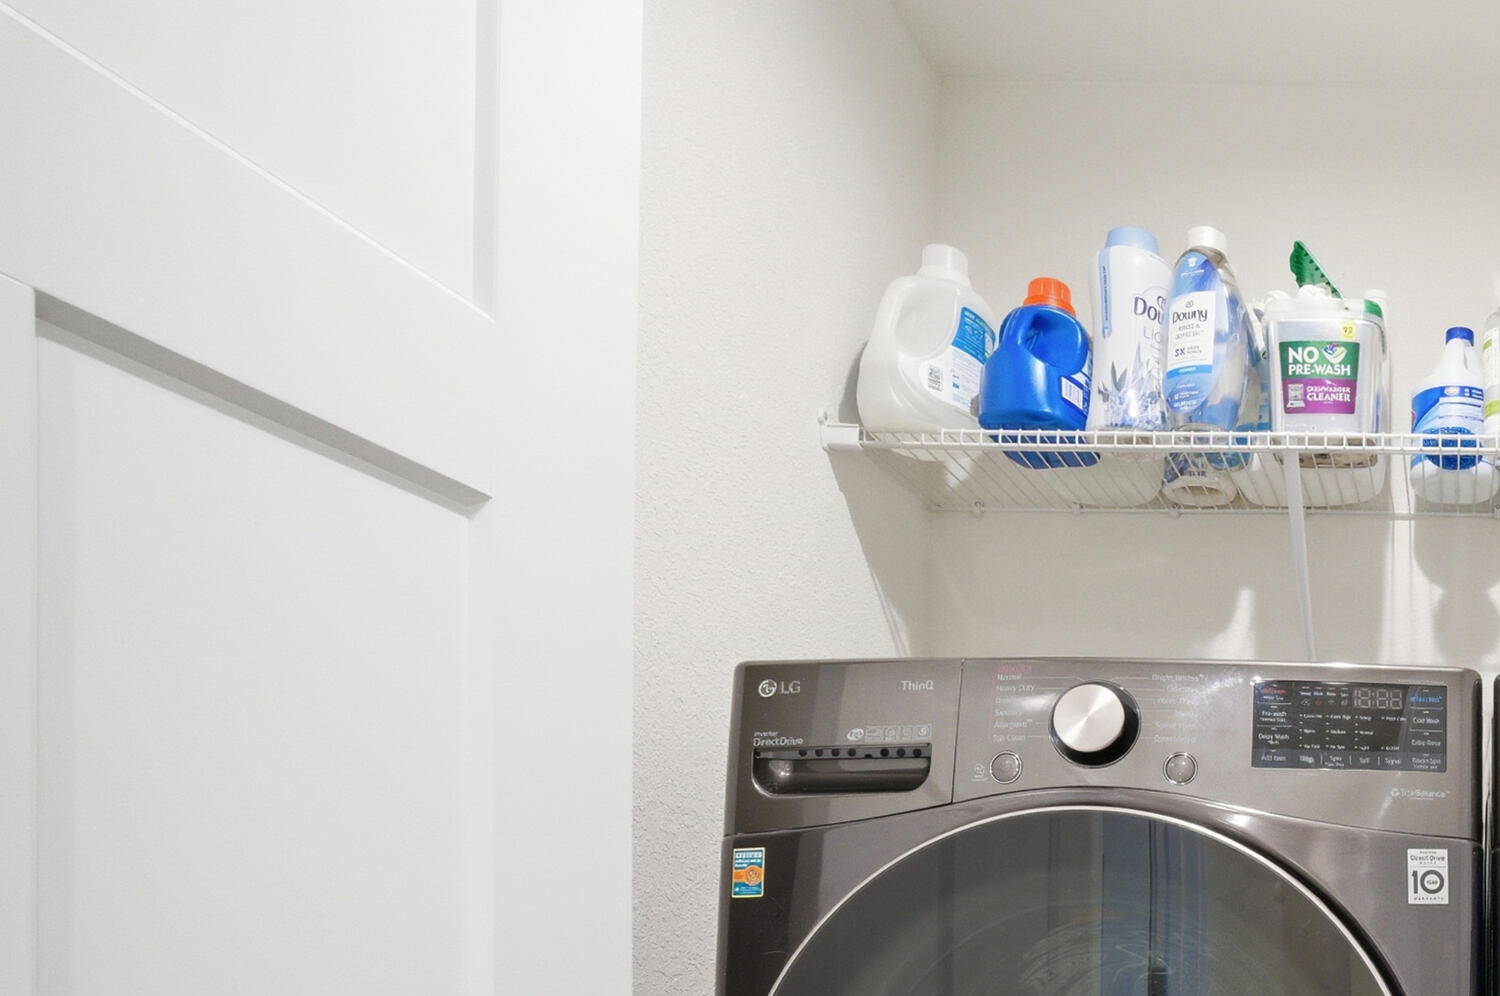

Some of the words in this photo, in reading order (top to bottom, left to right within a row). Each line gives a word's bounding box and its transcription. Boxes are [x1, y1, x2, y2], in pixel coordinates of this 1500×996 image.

[1172, 309, 1208, 324] Downy
[1288, 346, 1320, 364] NO
[1288, 364, 1351, 376] PRE-WASH
[1306, 392, 1351, 402] CLEANER
[781, 681, 801, 694] LG
[901, 680, 935, 691] ThinQ
[1411, 869, 1445, 895] 10
